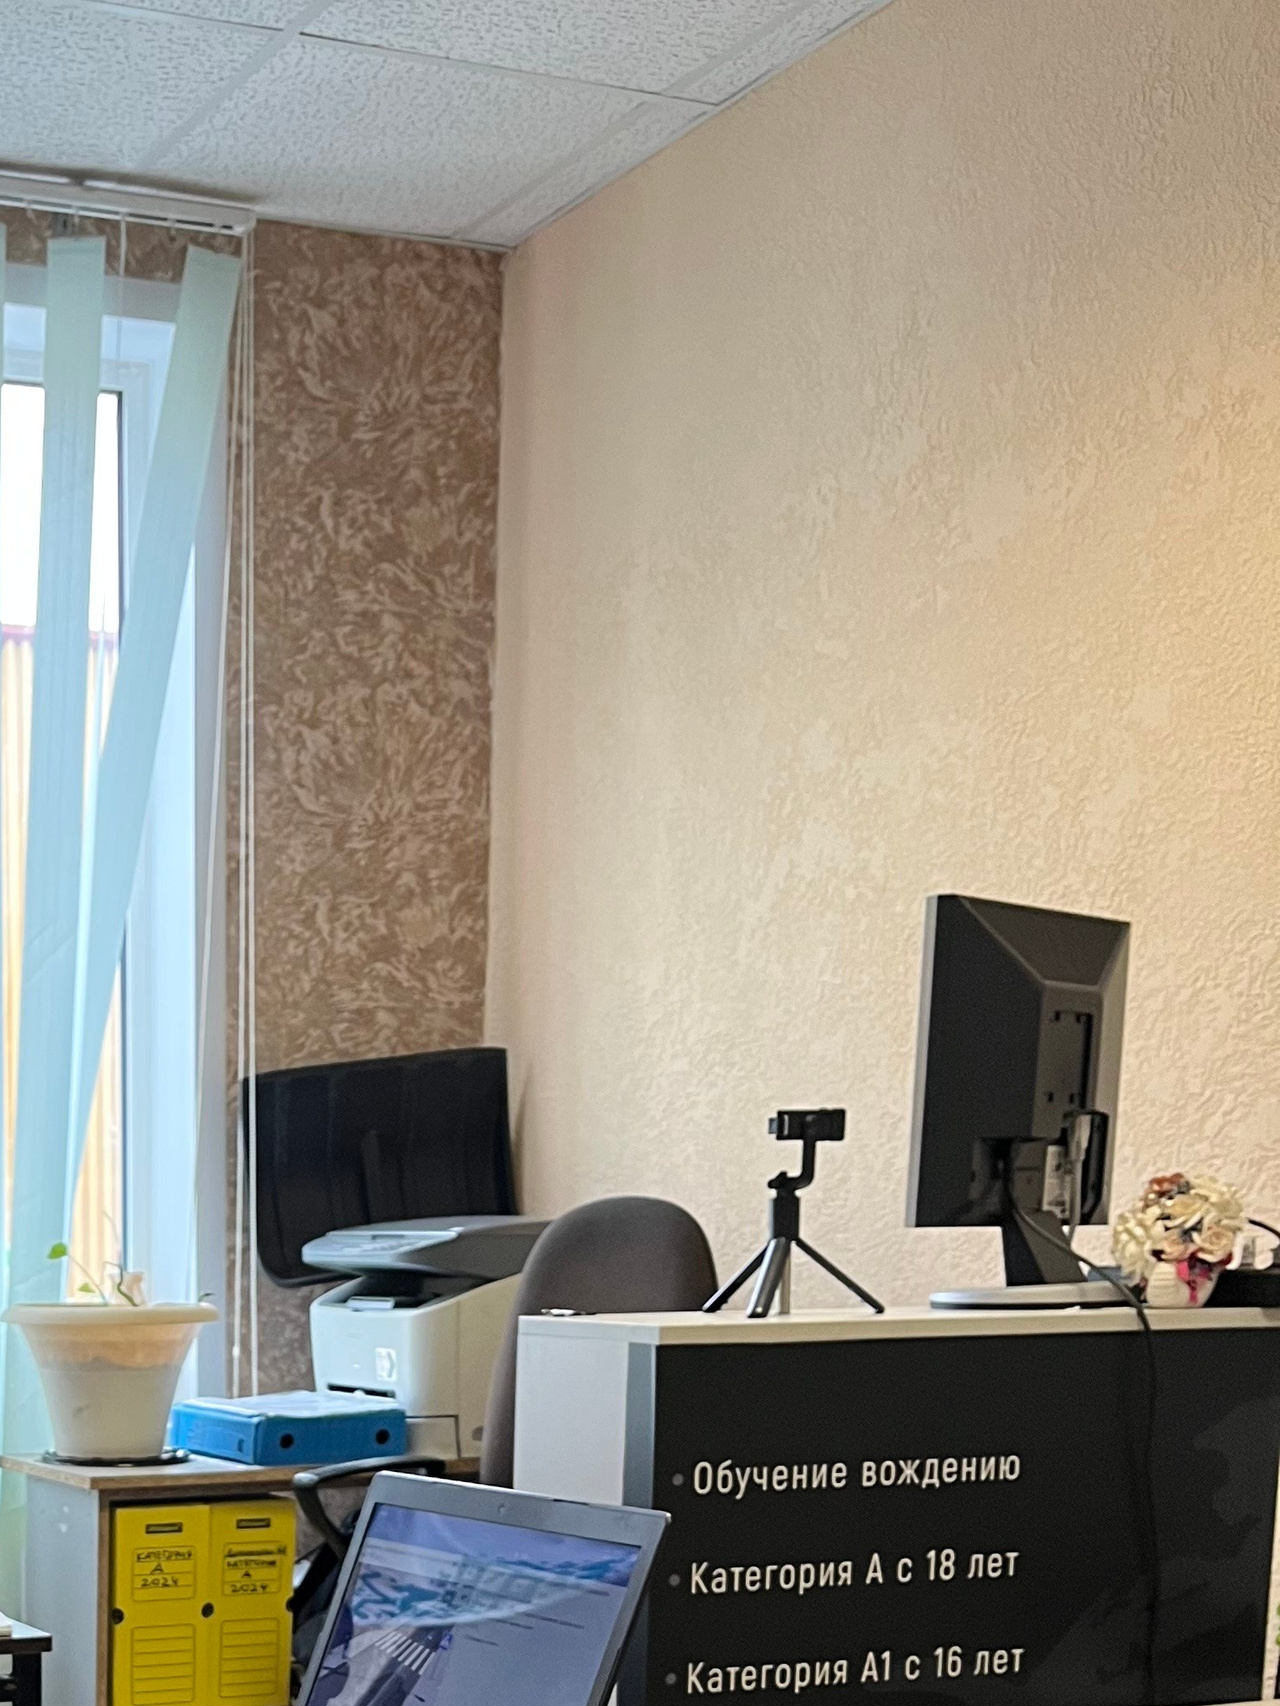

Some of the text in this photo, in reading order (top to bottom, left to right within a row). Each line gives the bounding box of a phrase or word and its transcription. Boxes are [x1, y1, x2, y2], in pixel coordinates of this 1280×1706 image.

[694, 1455, 1020, 1500] Обучение вождению
[691, 1548, 1019, 1595] Категория А с 18 лет
[687, 1645, 1024, 1694] Категория А1 с 16 лет
